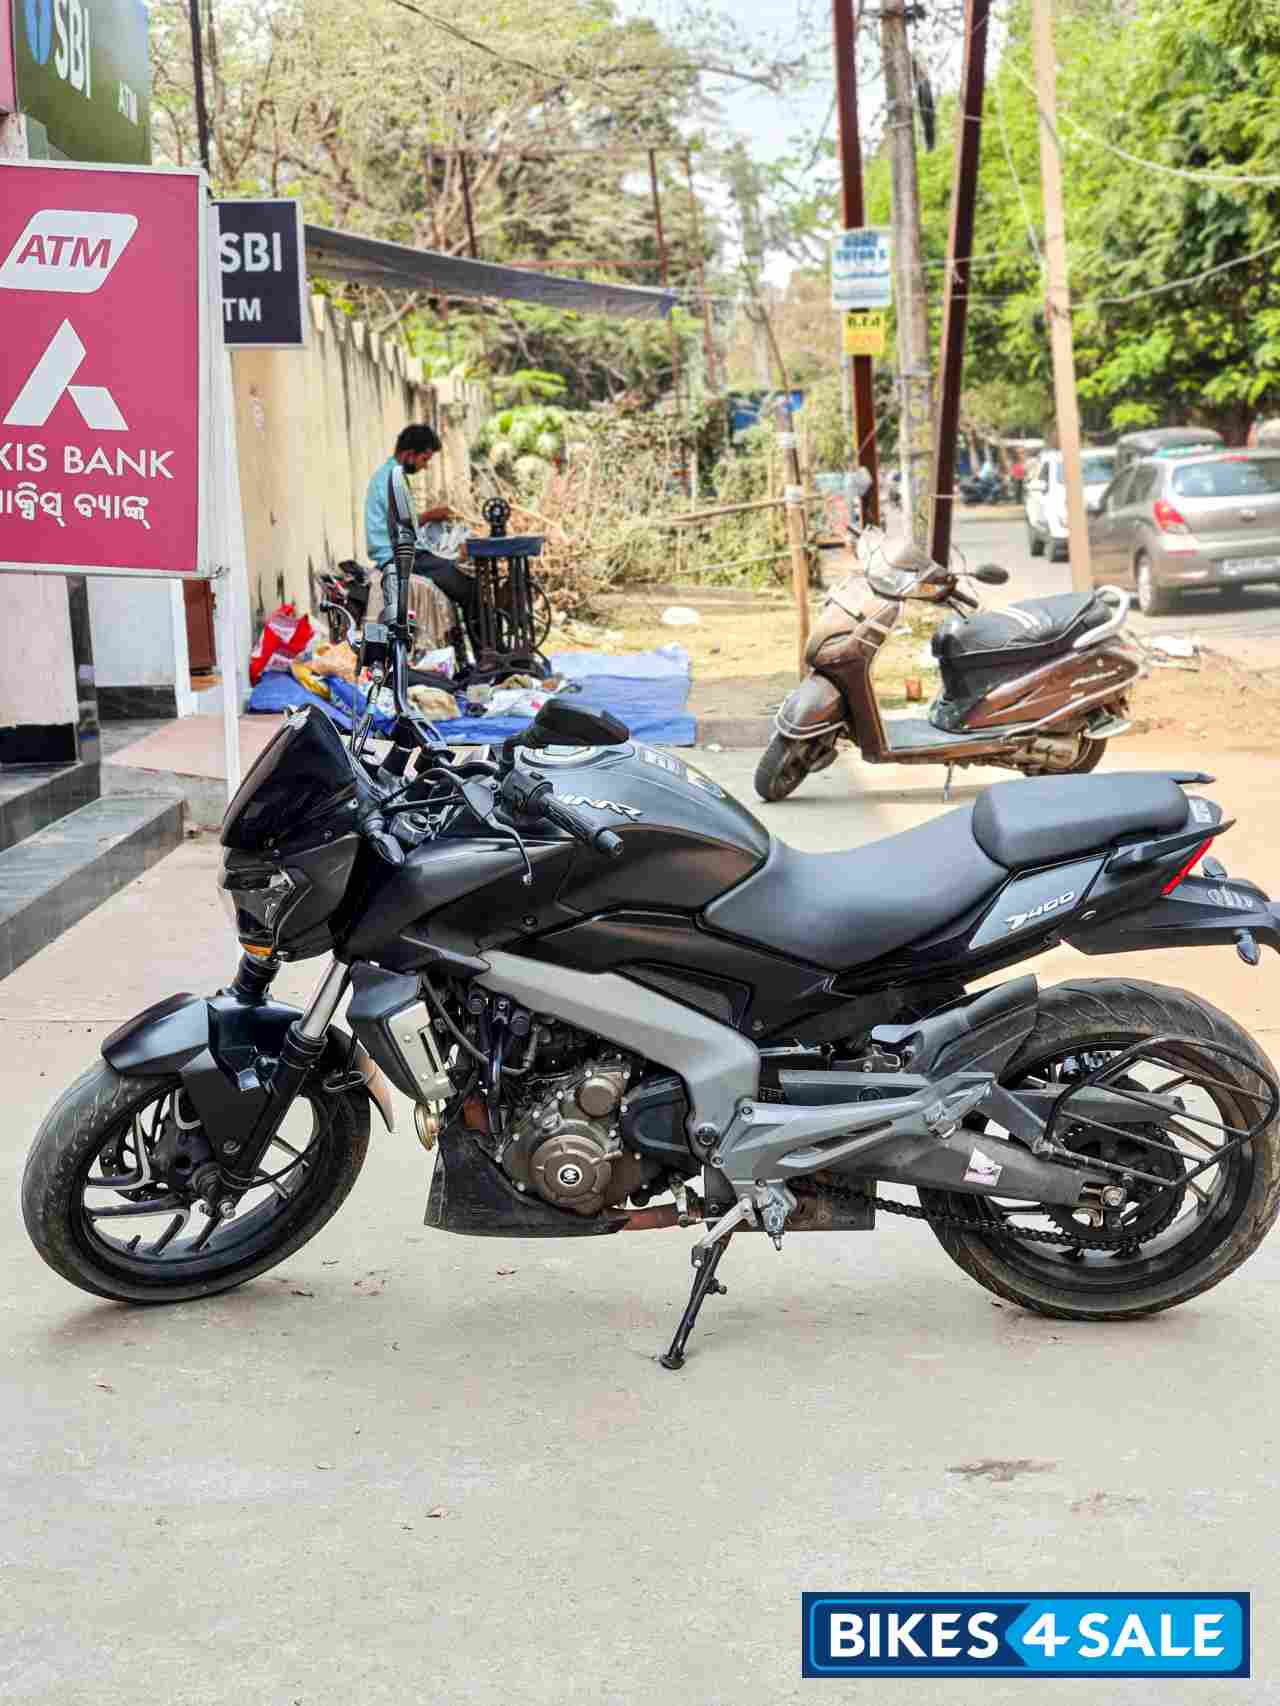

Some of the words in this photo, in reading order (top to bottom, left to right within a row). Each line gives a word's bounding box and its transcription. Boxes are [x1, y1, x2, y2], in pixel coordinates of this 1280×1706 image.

[54, 0, 91, 99] SBI
[16, 234, 112, 269] ATM
[219, 231, 282, 273] SBI
[222, 297, 262, 322] TM
[0, 442, 48, 473] XIS
[63, 445, 175, 479] BANK
